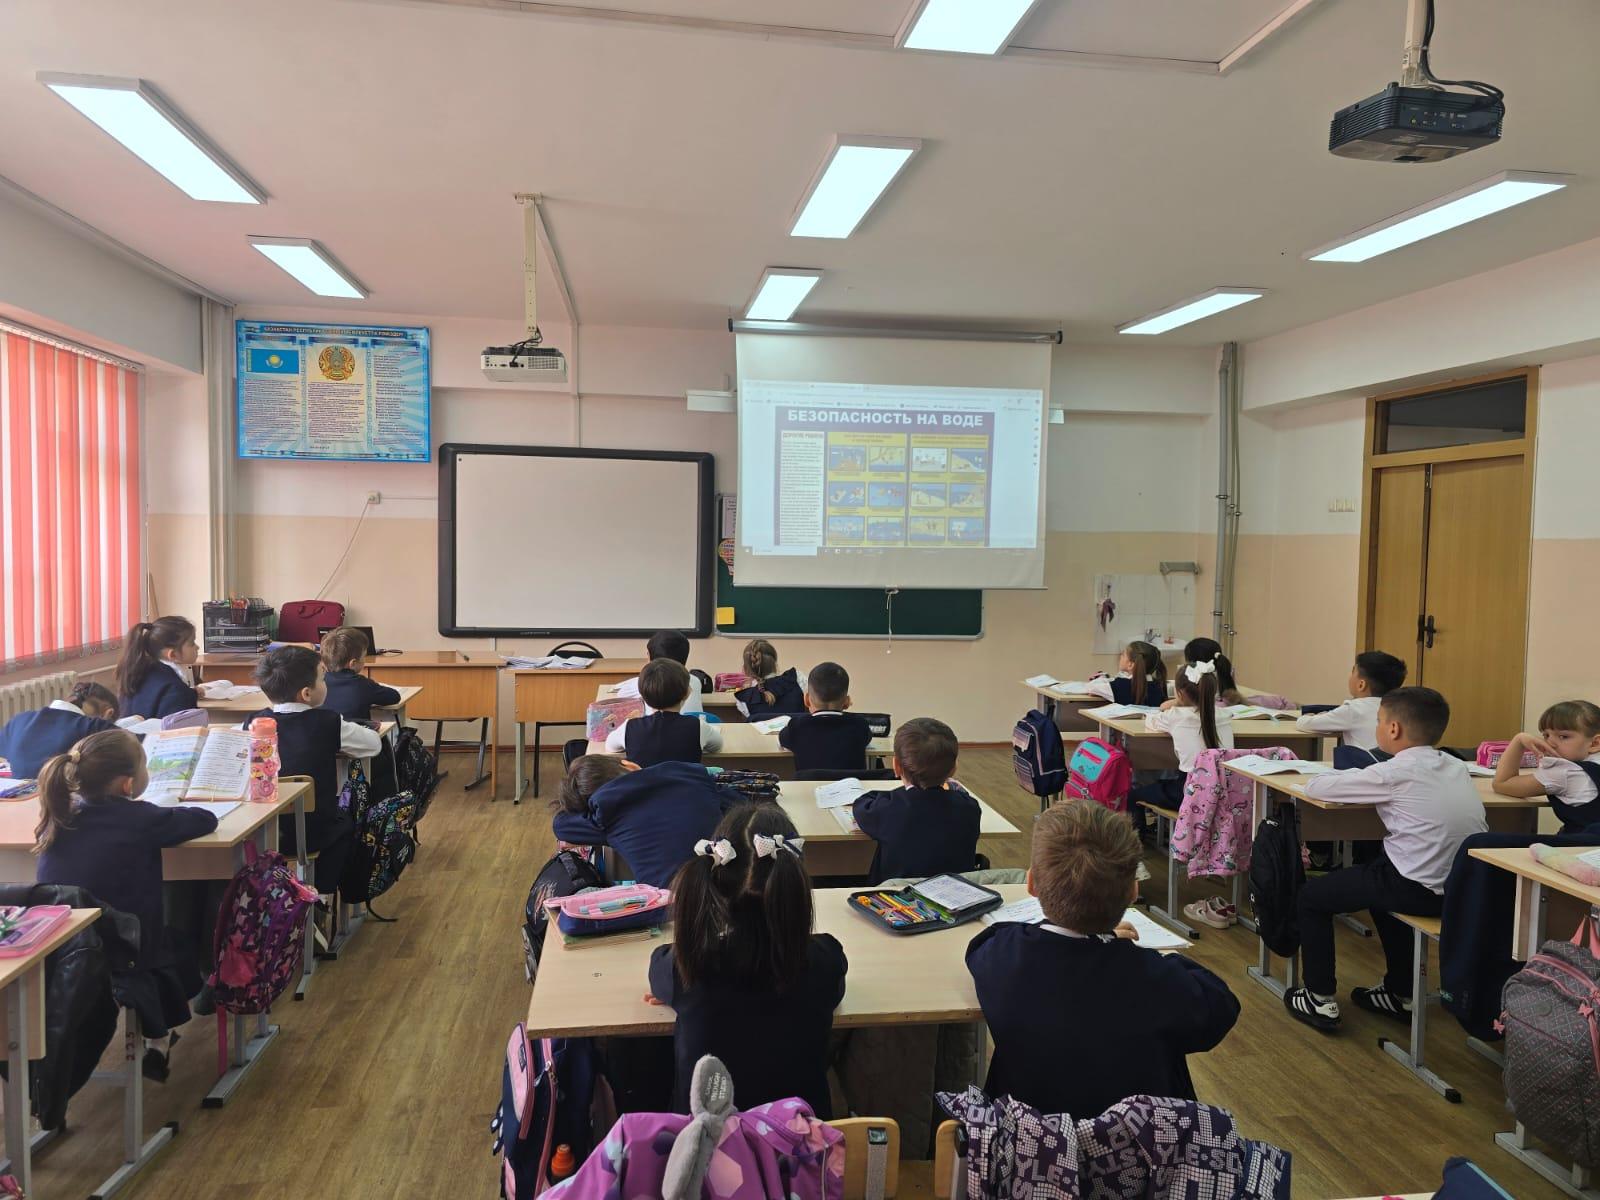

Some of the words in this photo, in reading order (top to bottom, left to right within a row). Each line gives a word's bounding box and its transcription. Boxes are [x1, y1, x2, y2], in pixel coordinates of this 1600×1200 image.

[787, 409, 912, 425] БЕЗОПАСНОСТЬ
[917, 415, 938, 425] НА
[942, 415, 983, 427] ВОДЕ
